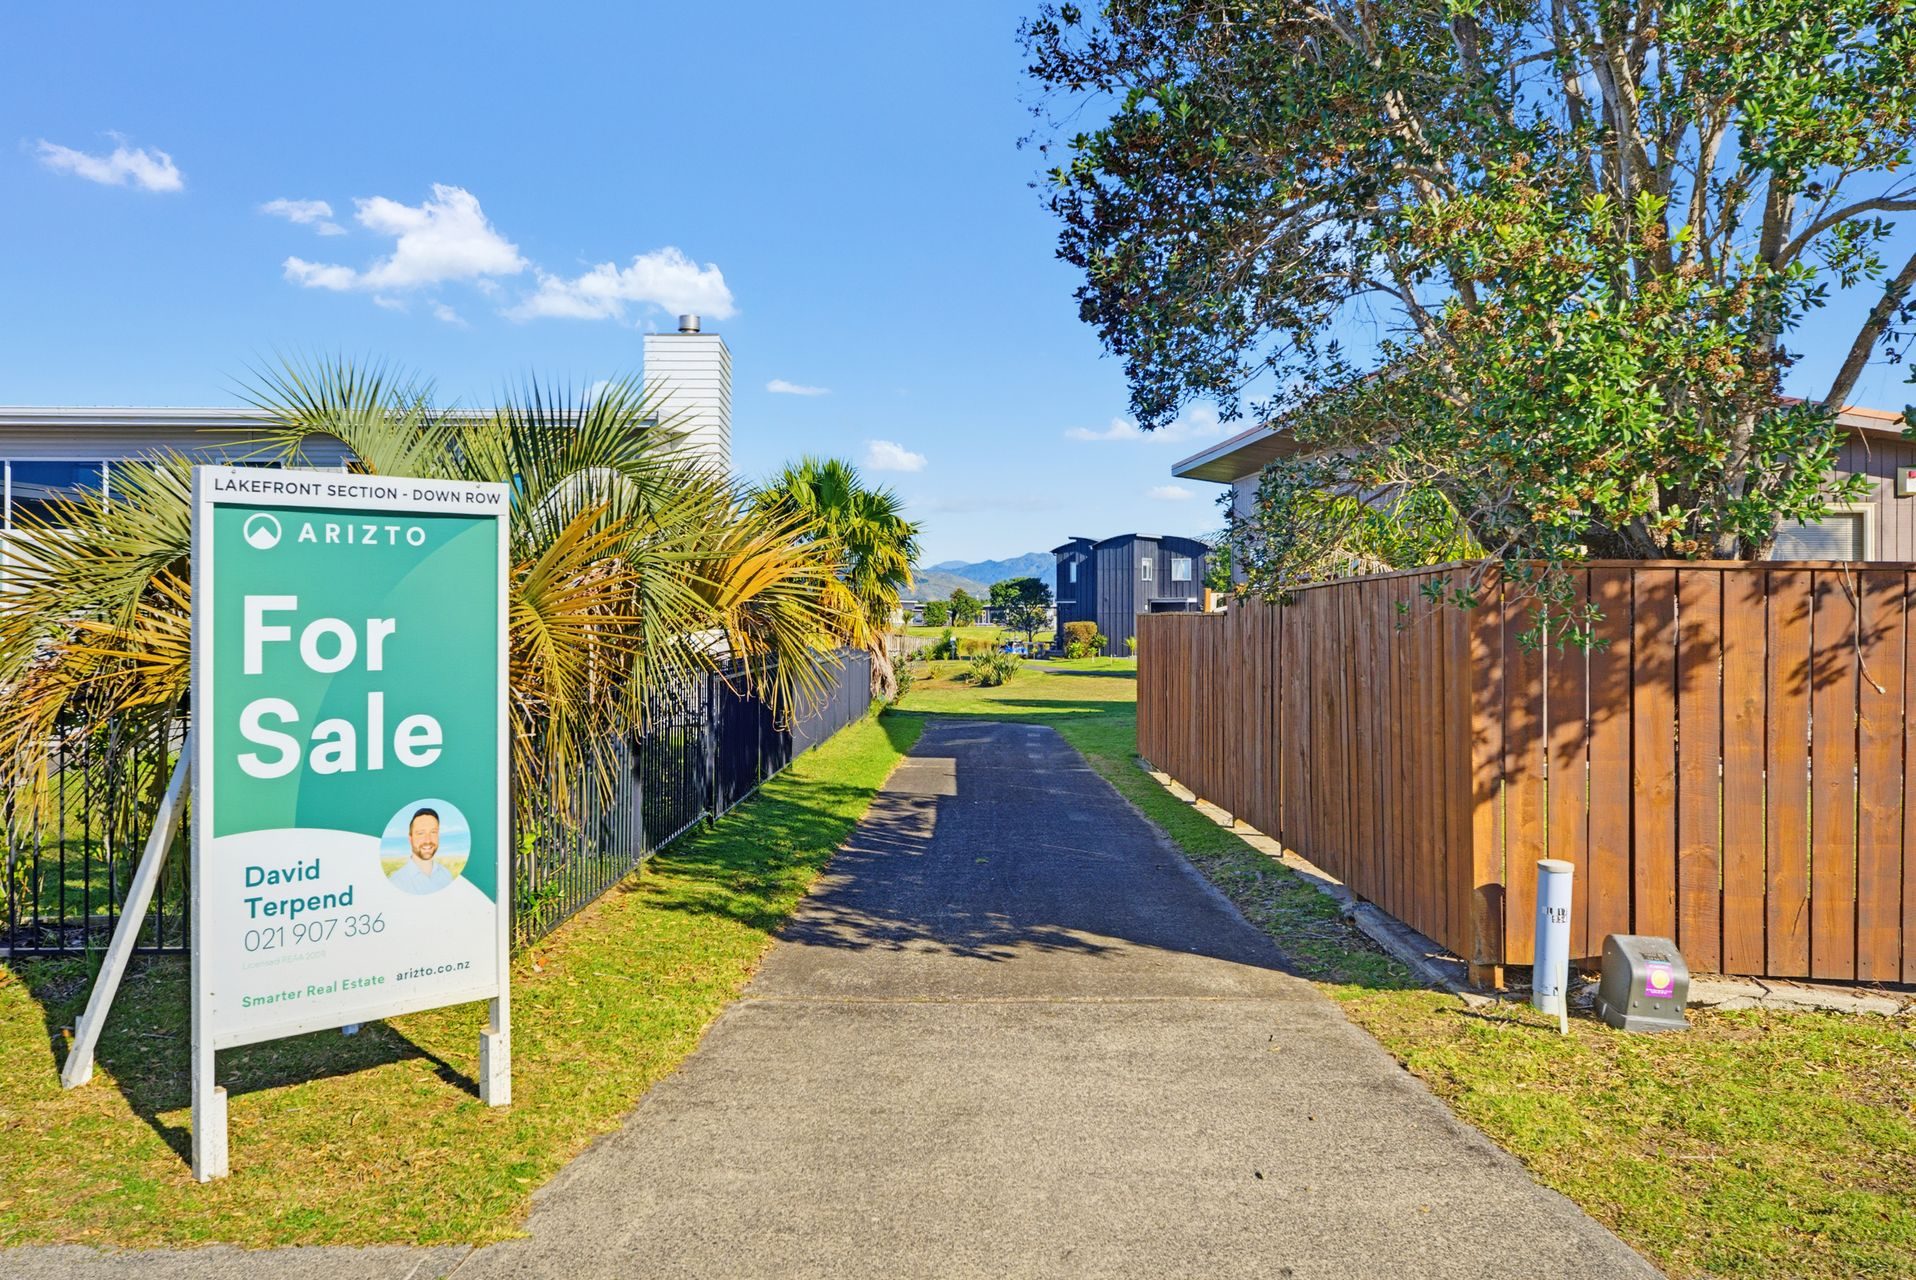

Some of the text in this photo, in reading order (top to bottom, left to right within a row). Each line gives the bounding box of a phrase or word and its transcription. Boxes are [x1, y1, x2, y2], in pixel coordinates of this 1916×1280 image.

[214, 478, 322, 496] LAKEFRONT
[327, 484, 397, 500] SECTION
[412, 489, 460, 503] DOWN
[465, 492, 501, 505] ROW
[298, 522, 426, 546] ARIZTO
[244, 595, 396, 675] For
[237, 691, 443, 779] Sale
[245, 858, 320, 888] David
[244, 885, 353, 920] Terpend
[244, 912, 386, 952] 021 907 336
[396, 960, 471, 981] arizto.co.nz
[242, 975, 385, 1008] Smarter Real Estate
